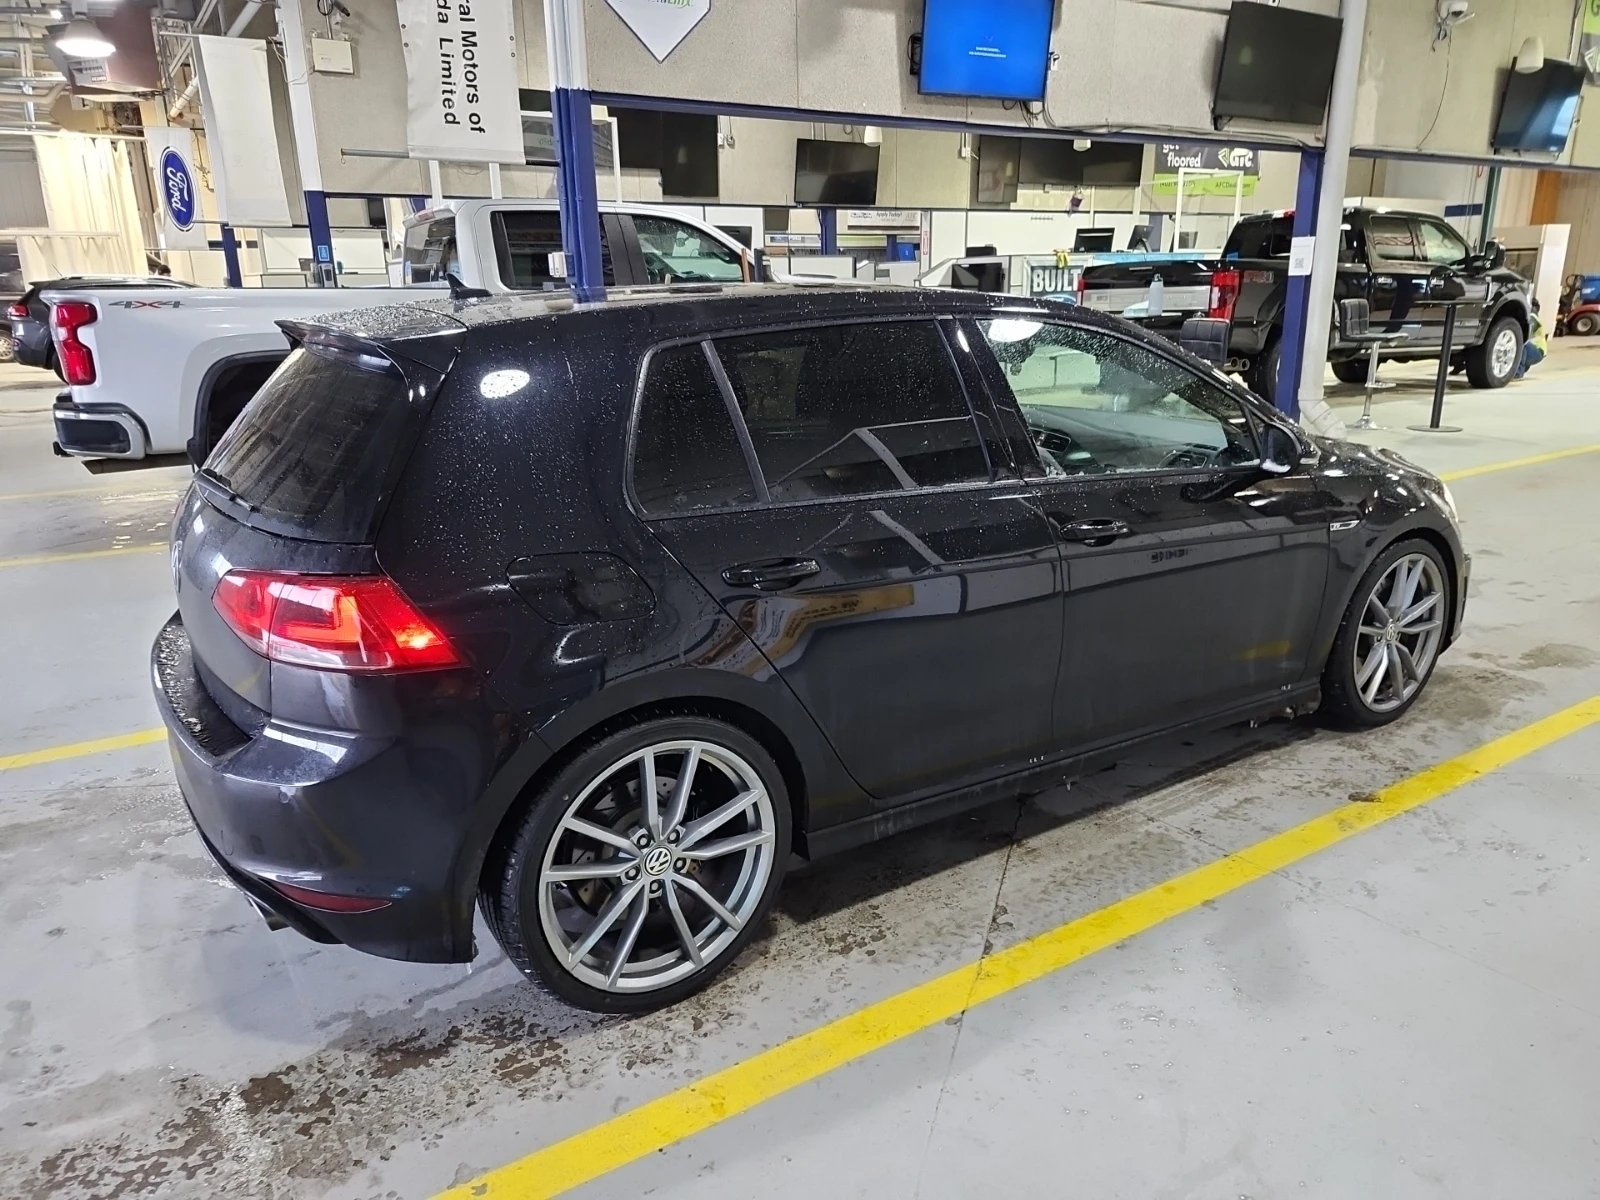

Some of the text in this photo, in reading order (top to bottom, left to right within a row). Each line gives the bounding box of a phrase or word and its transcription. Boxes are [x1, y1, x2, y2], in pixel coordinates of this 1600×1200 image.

[439, 37, 461, 125] Limited
[461, 30, 479, 104] Motors
[468, 112, 486, 134] of
[1167, 152, 1202, 167] floored
[167, 166, 189, 213] Ford
[1032, 268, 1081, 292] BUILT
